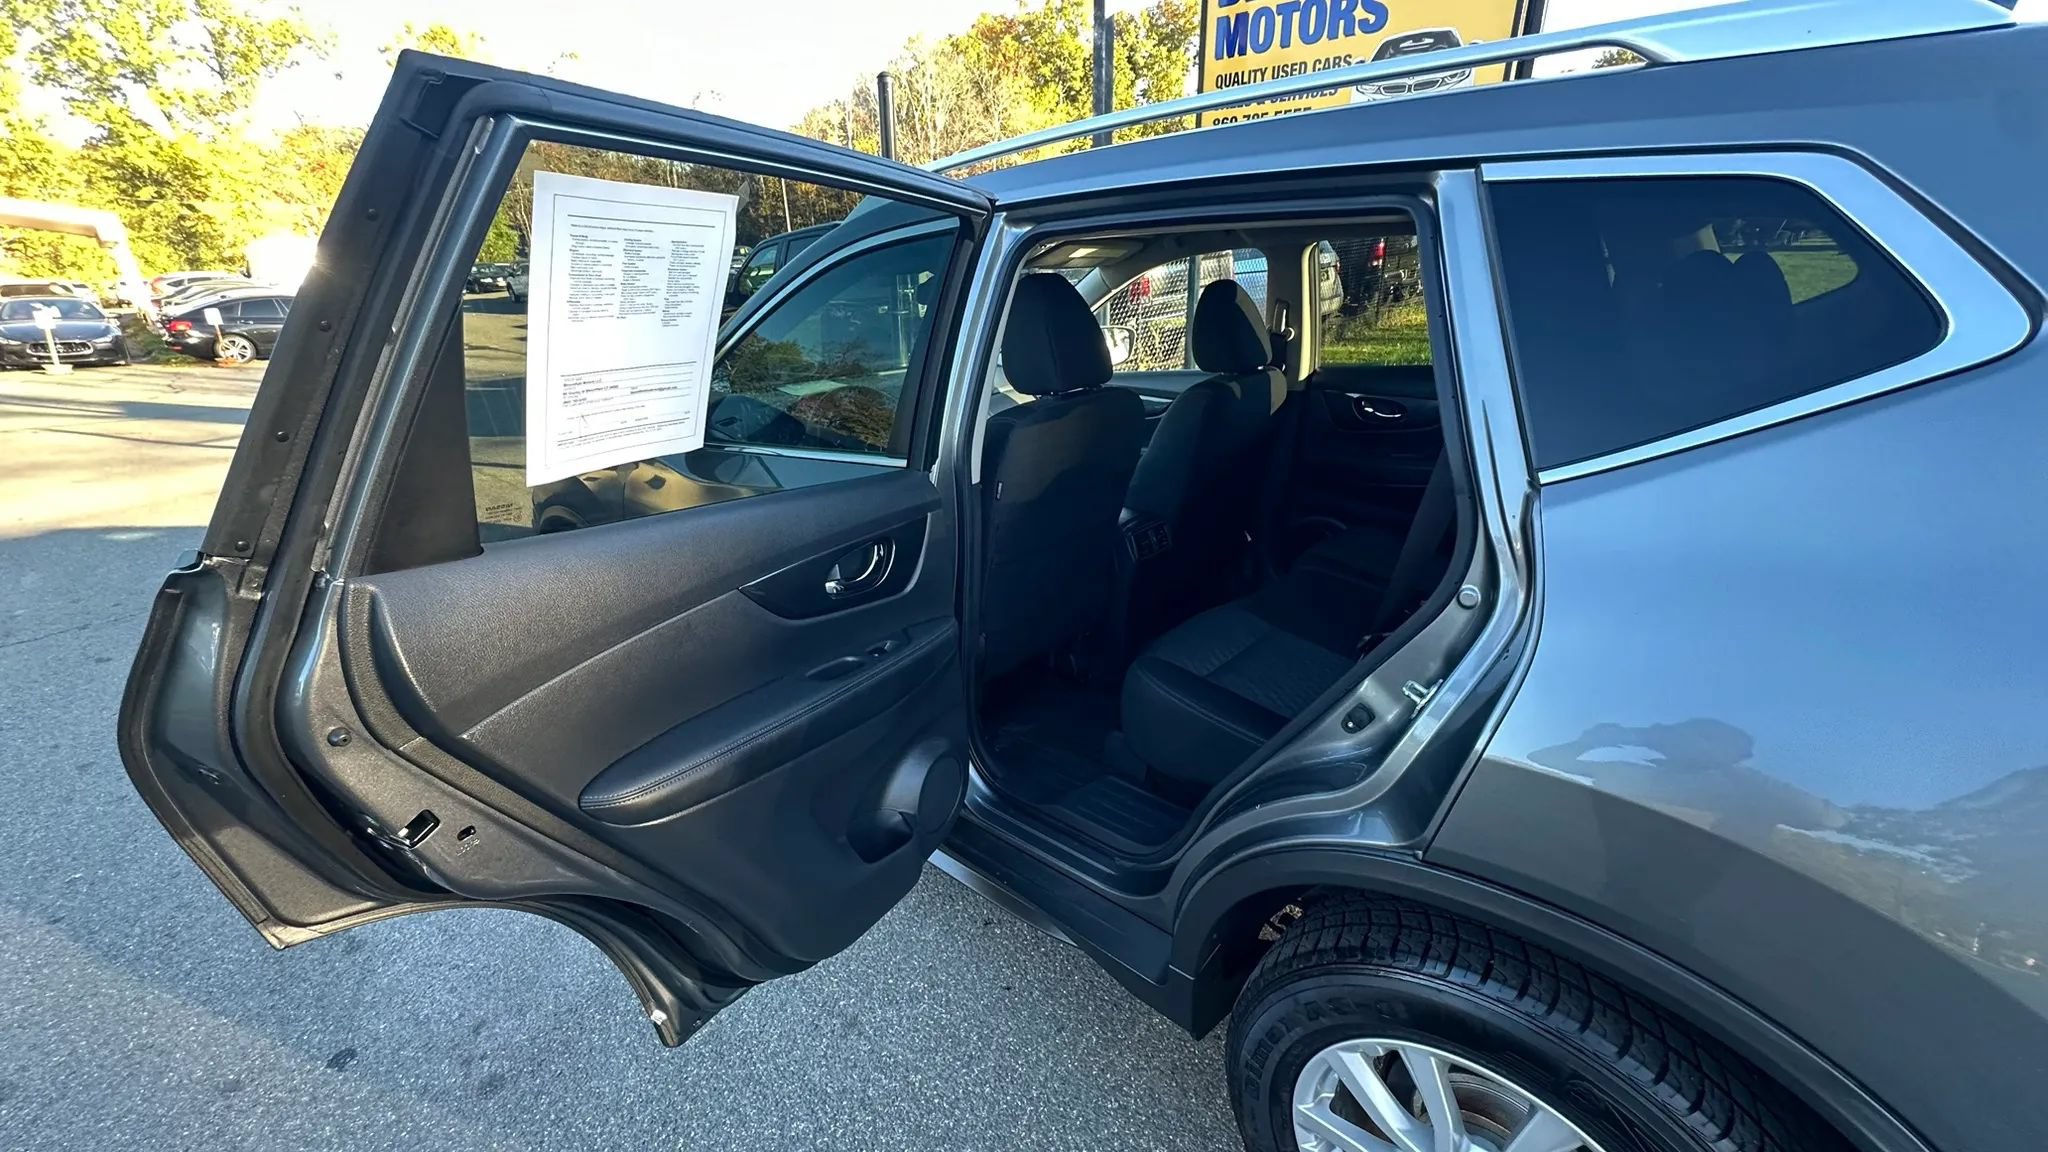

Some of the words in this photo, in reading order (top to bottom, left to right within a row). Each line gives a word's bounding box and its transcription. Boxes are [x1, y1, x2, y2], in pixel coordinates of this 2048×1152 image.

[1214, 0, 1389, 60] MOTORS
[1215, 67, 1268, 90] QUALITY
[1271, 60, 1308, 80] USED
[1312, 54, 1352, 73] CARS
